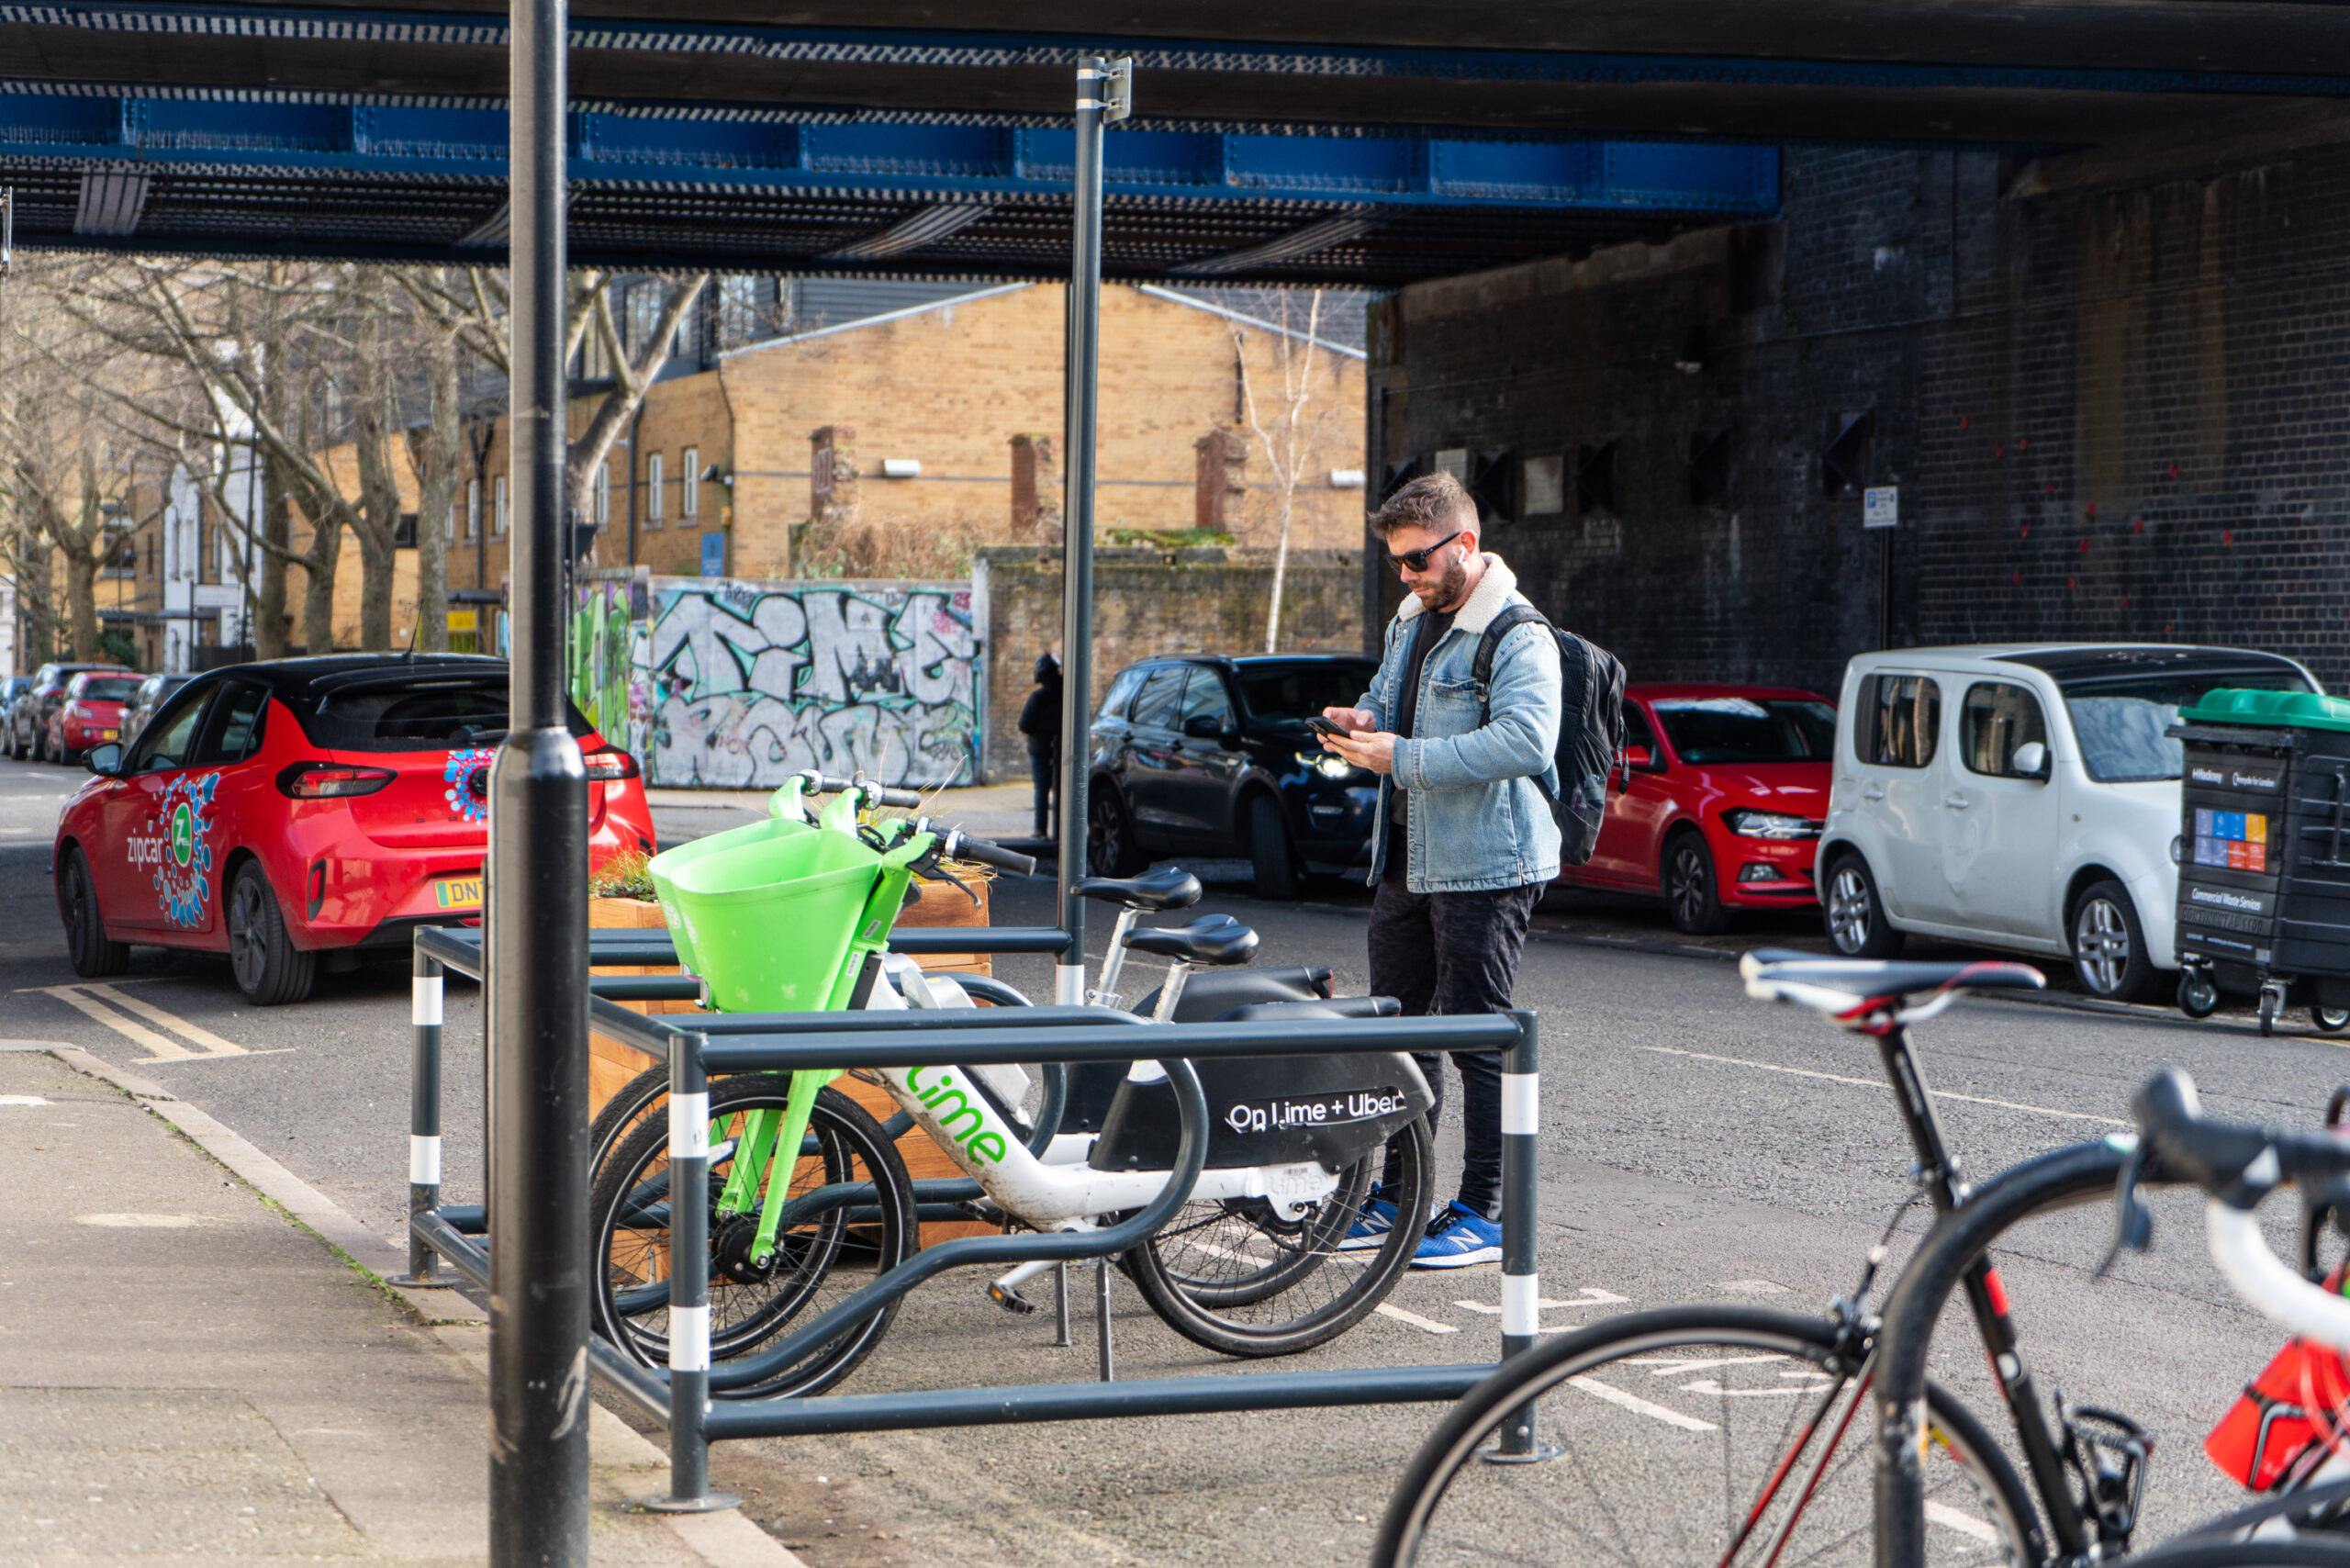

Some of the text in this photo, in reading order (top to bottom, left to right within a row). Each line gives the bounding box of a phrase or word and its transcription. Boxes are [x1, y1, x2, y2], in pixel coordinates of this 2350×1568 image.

[127, 837, 163, 872] zipcar
[2191, 888, 2262, 911] Commercial Waste Services
[1229, 1104, 1267, 1130] On
[1271, 1101, 1327, 1126] Lime
[1348, 1093, 1399, 1117] Uber
